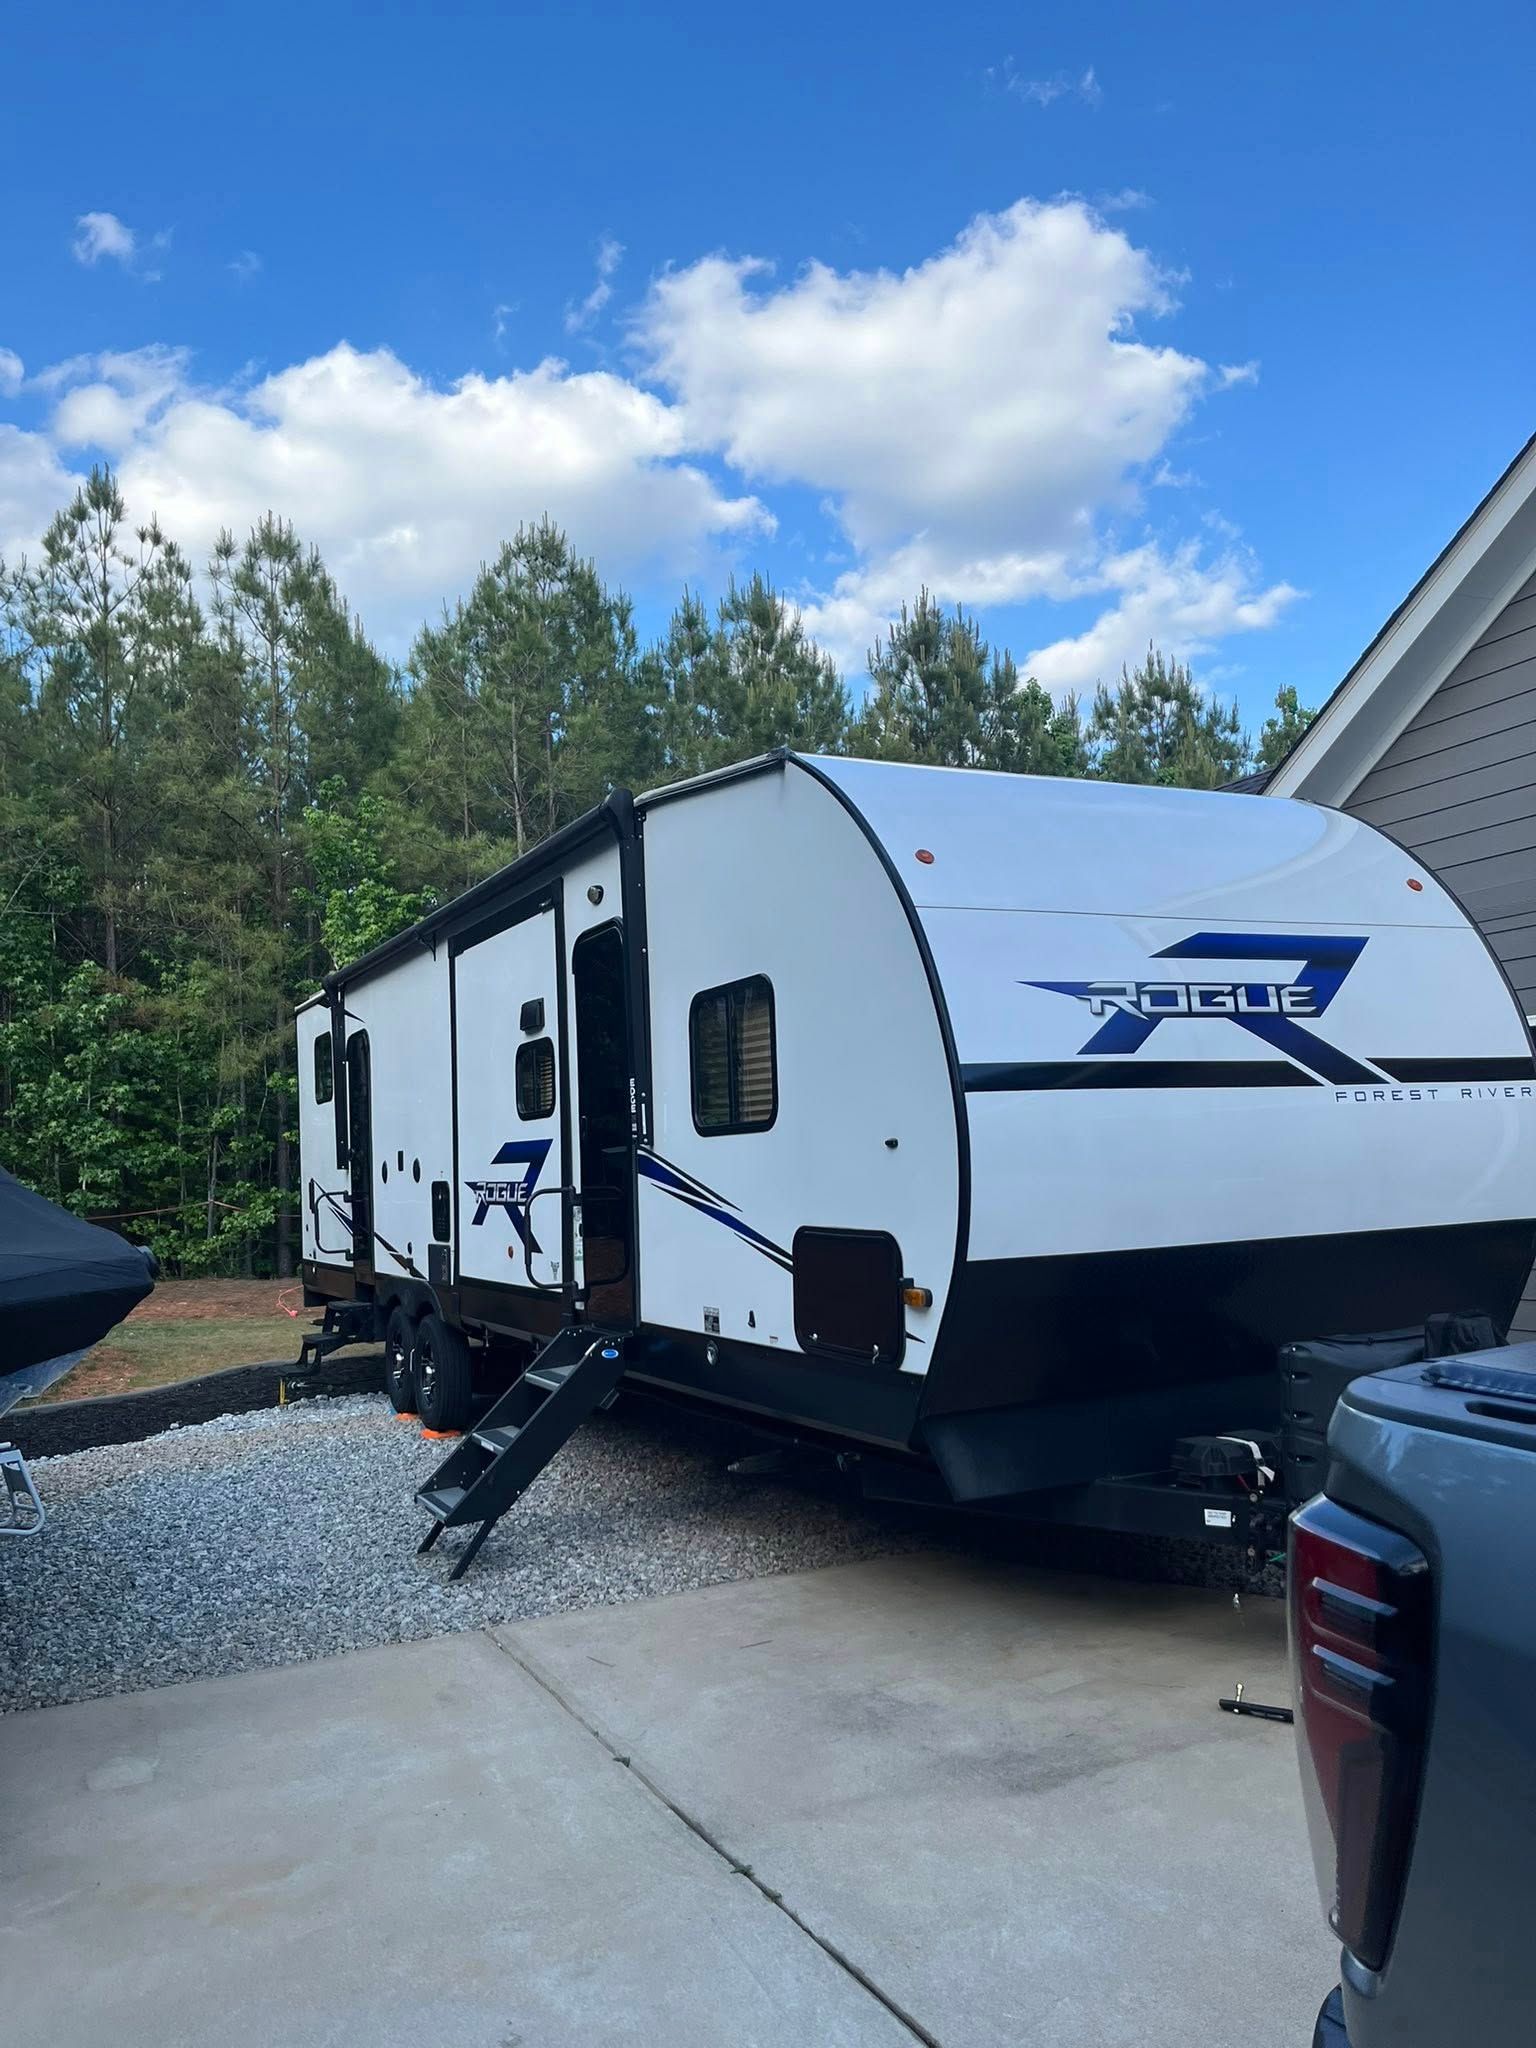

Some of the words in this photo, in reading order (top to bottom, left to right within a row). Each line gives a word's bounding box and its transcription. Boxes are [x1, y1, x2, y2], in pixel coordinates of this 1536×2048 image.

[1075, 980, 1317, 1021] ROGUE
[1335, 1088, 1439, 1103] FOREST
[1460, 1086, 1533, 1099] RIVER
[474, 1181, 529, 1206] ROGUE
